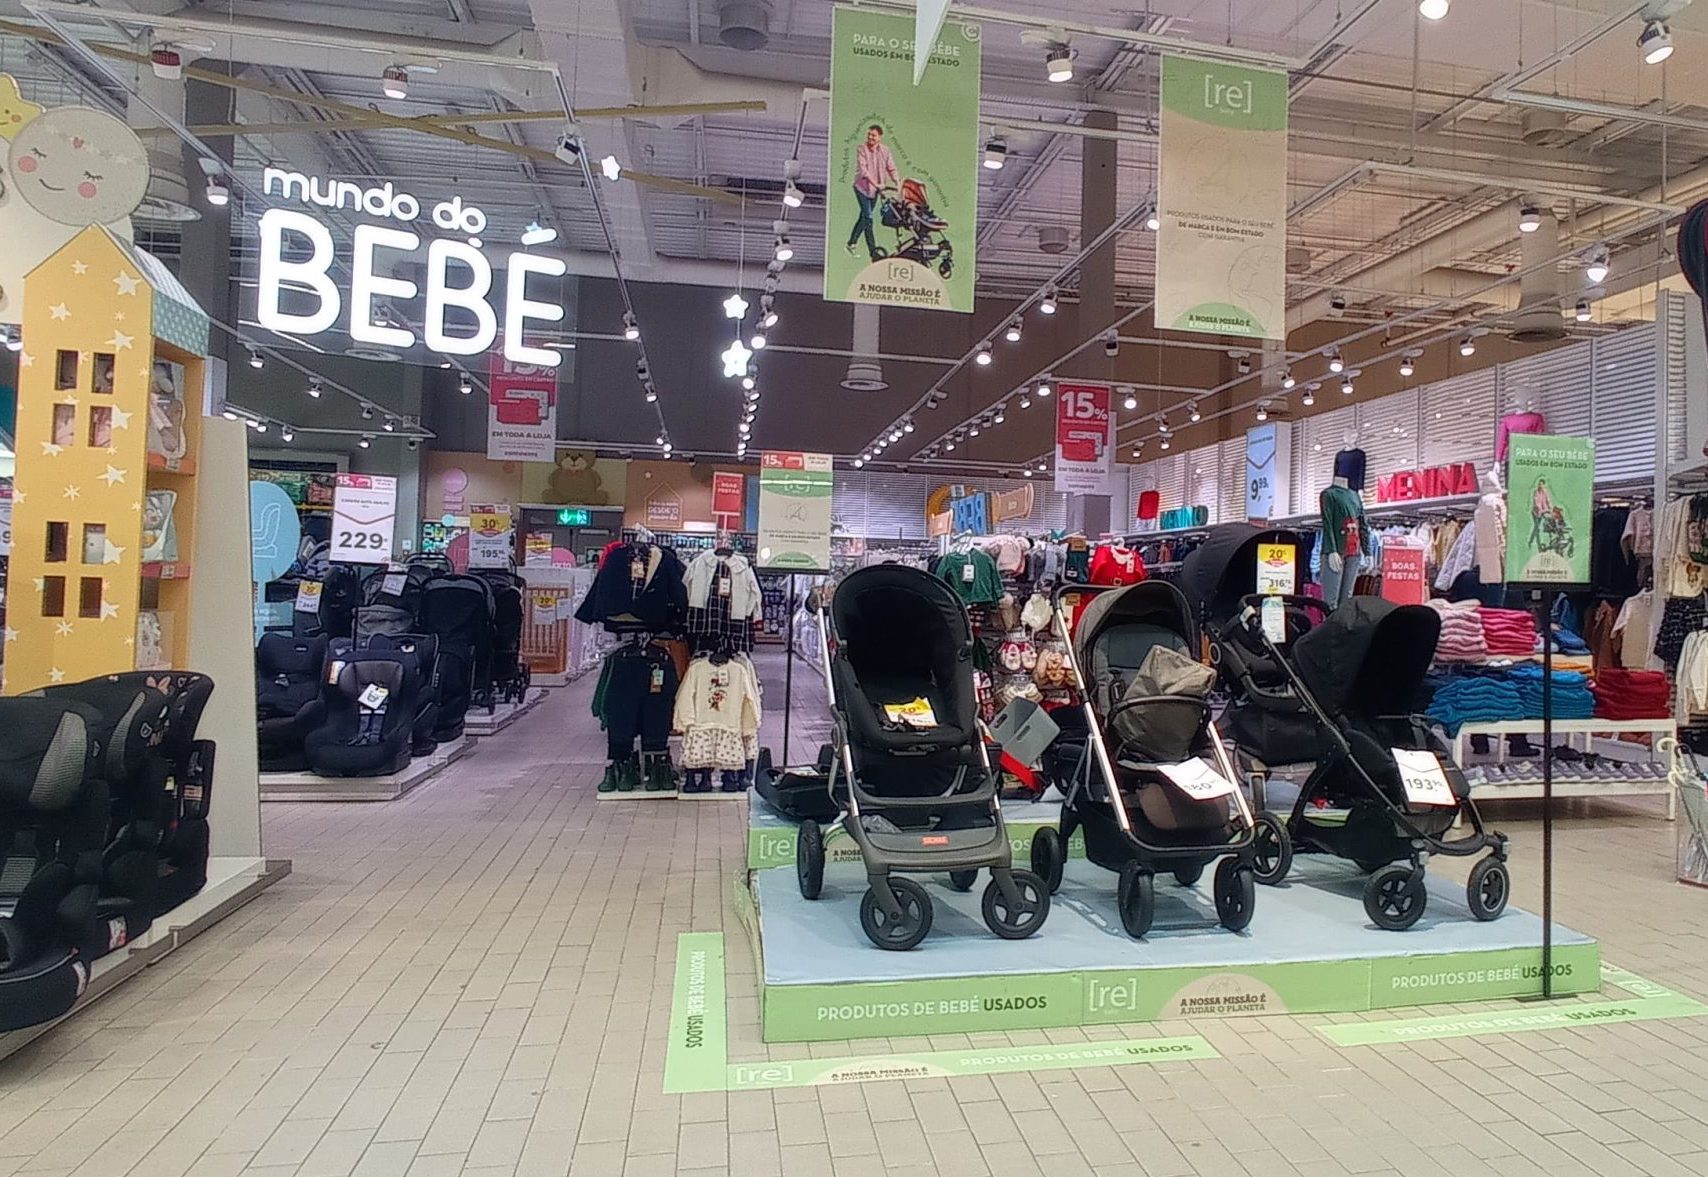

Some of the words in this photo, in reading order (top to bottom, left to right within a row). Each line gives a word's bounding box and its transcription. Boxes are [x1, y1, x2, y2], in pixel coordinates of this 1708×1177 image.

[853, 33, 885, 47] PARA
[889, 38, 899, 49] O
[902, 40, 916, 50] SE
[853, 47, 888, 59] USADOS
[890, 52, 903, 60] EM
[264, 167, 421, 222] mundo
[432, 195, 487, 234] do
[1188, 223, 1210, 231] MARCA
[1226, 226, 1240, 234] BOM
[1241, 229, 1264, 237] ESTADO
[257, 208, 567, 367] BEBÉ
[859, 283, 866, 292] A
[868, 284, 897, 295] NOSSA
[900, 287, 933, 298] MISSÃO
[859, 291, 893, 301] AJUDAR
[903, 295, 940, 305] PLANETA
[1061, 391, 1108, 420] 15%
[1540, 448, 1548, 458] O
[1376, 462, 1479, 503] MENINA
[1392, 562, 1416, 570] BOAS
[1387, 571, 1420, 580] FESTAS
[833, 849, 840, 857] A
[841, 849, 863, 857] NOSS
[1392, 972, 1465, 989] PRODUTOS
[1467, 970, 1485, 983] DE
[1487, 964, 1519, 981] BEBÉ
[1090, 978, 1137, 1012] [re]
[1180, 998, 1188, 1007] A
[1189, 997, 1221, 1006] NOSSA
[1223, 993, 1259, 1005] MISSÃO
[1260, 993, 1267, 1003] É
[817, 1003, 909, 1020] PRODUTOS
[913, 1001, 935, 1016] DE
[939, 995, 979, 1014] BEBÉ
[984, 996, 1047, 1011] USADOS
[1180, 1005, 1216, 1015] AJUDAR
[1218, 1005, 1225, 1013] O
[1227, 1003, 1266, 1013] PLANETA
[1392, 1020, 1494, 1036] PRODUTOS
[1498, 1017, 1521, 1028] DE
[1522, 1012, 1566, 1025] BEBÉ
[1566, 1008, 1637, 1021] USADOS
[685, 1014, 704, 1048] USADOS
[960, 1053, 1054, 1067] PRODUTOS
[1057, 1051, 1080, 1061] DE
[1083, 1047, 1125, 1059] BEBÉ
[1127, 1044, 1194, 1055] USADOS
[736, 1065, 793, 1085] [re]
[841, 1070, 877, 1078] NOSSA
[879, 1067, 920, 1075] MISSÃO
